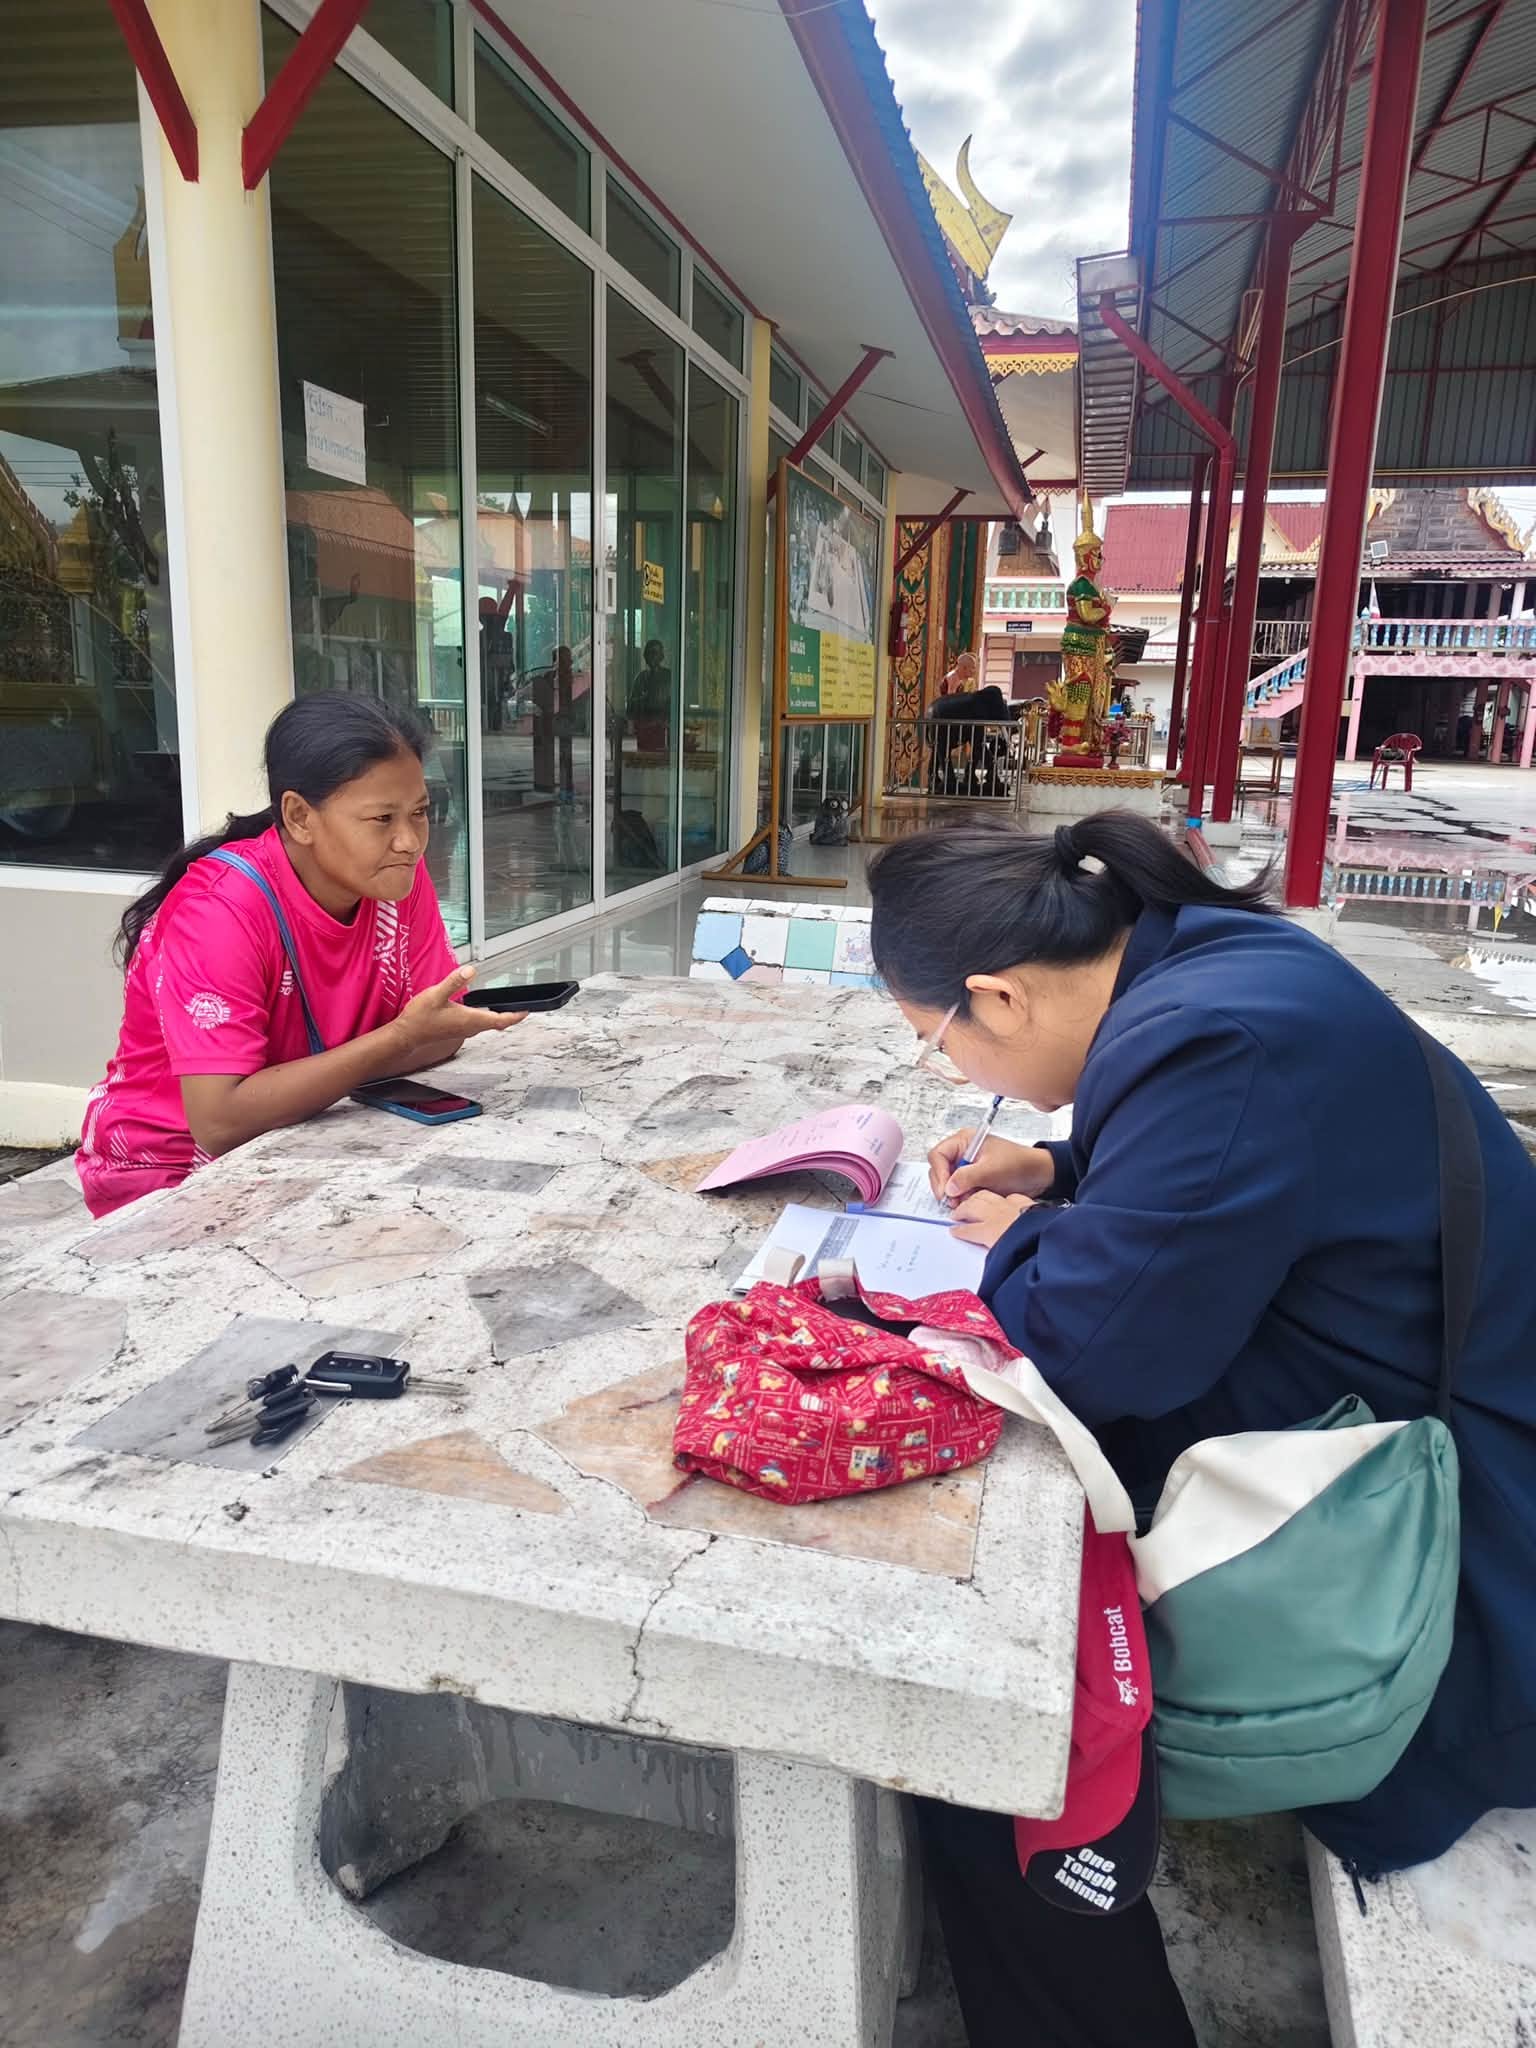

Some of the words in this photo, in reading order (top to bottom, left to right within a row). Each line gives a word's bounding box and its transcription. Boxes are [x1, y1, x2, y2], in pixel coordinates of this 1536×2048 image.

[1103, 1605, 1133, 1672] Bobcat
[1063, 1853, 1118, 1893] Tough
[1078, 1847, 1116, 1873] One
[1054, 1868, 1115, 1911] Animal
